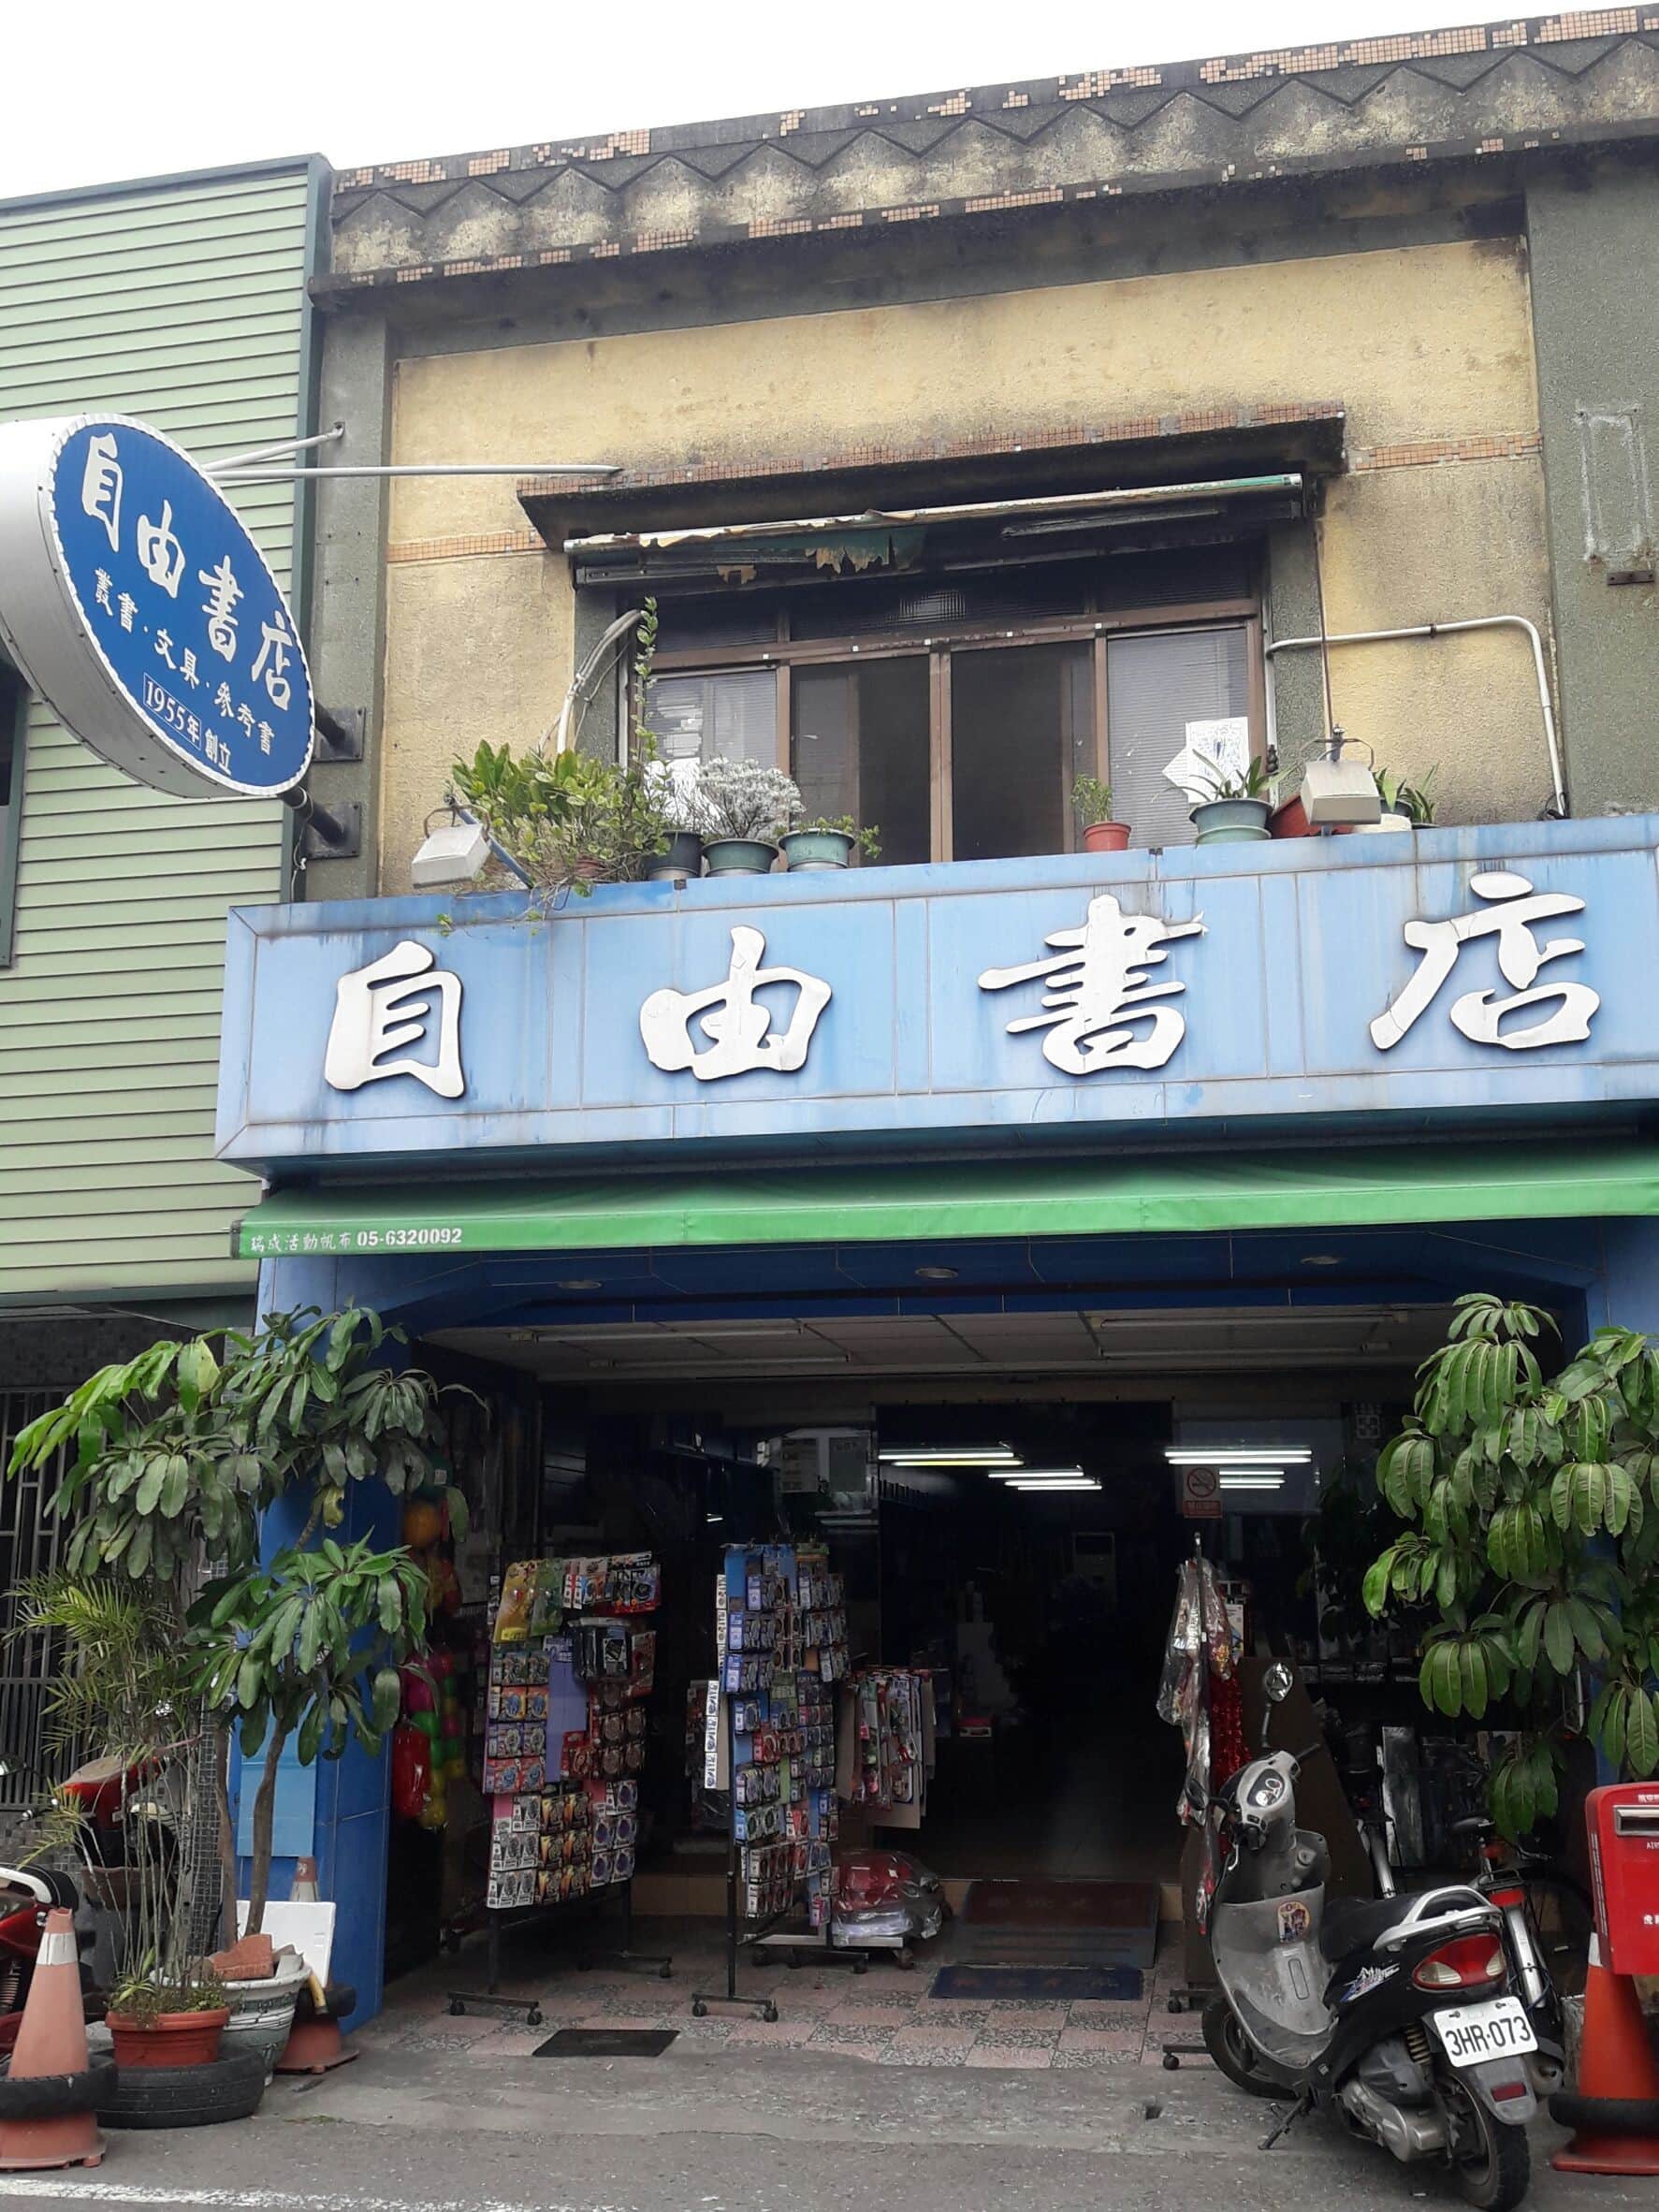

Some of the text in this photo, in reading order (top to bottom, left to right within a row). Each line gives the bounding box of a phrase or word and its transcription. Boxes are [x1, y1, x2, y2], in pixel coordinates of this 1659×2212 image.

[81, 432, 293, 711] 自由書店
[325, 871, 1601, 1099] 自由書店
[357, 1228, 462, 1247] 05-6320092
